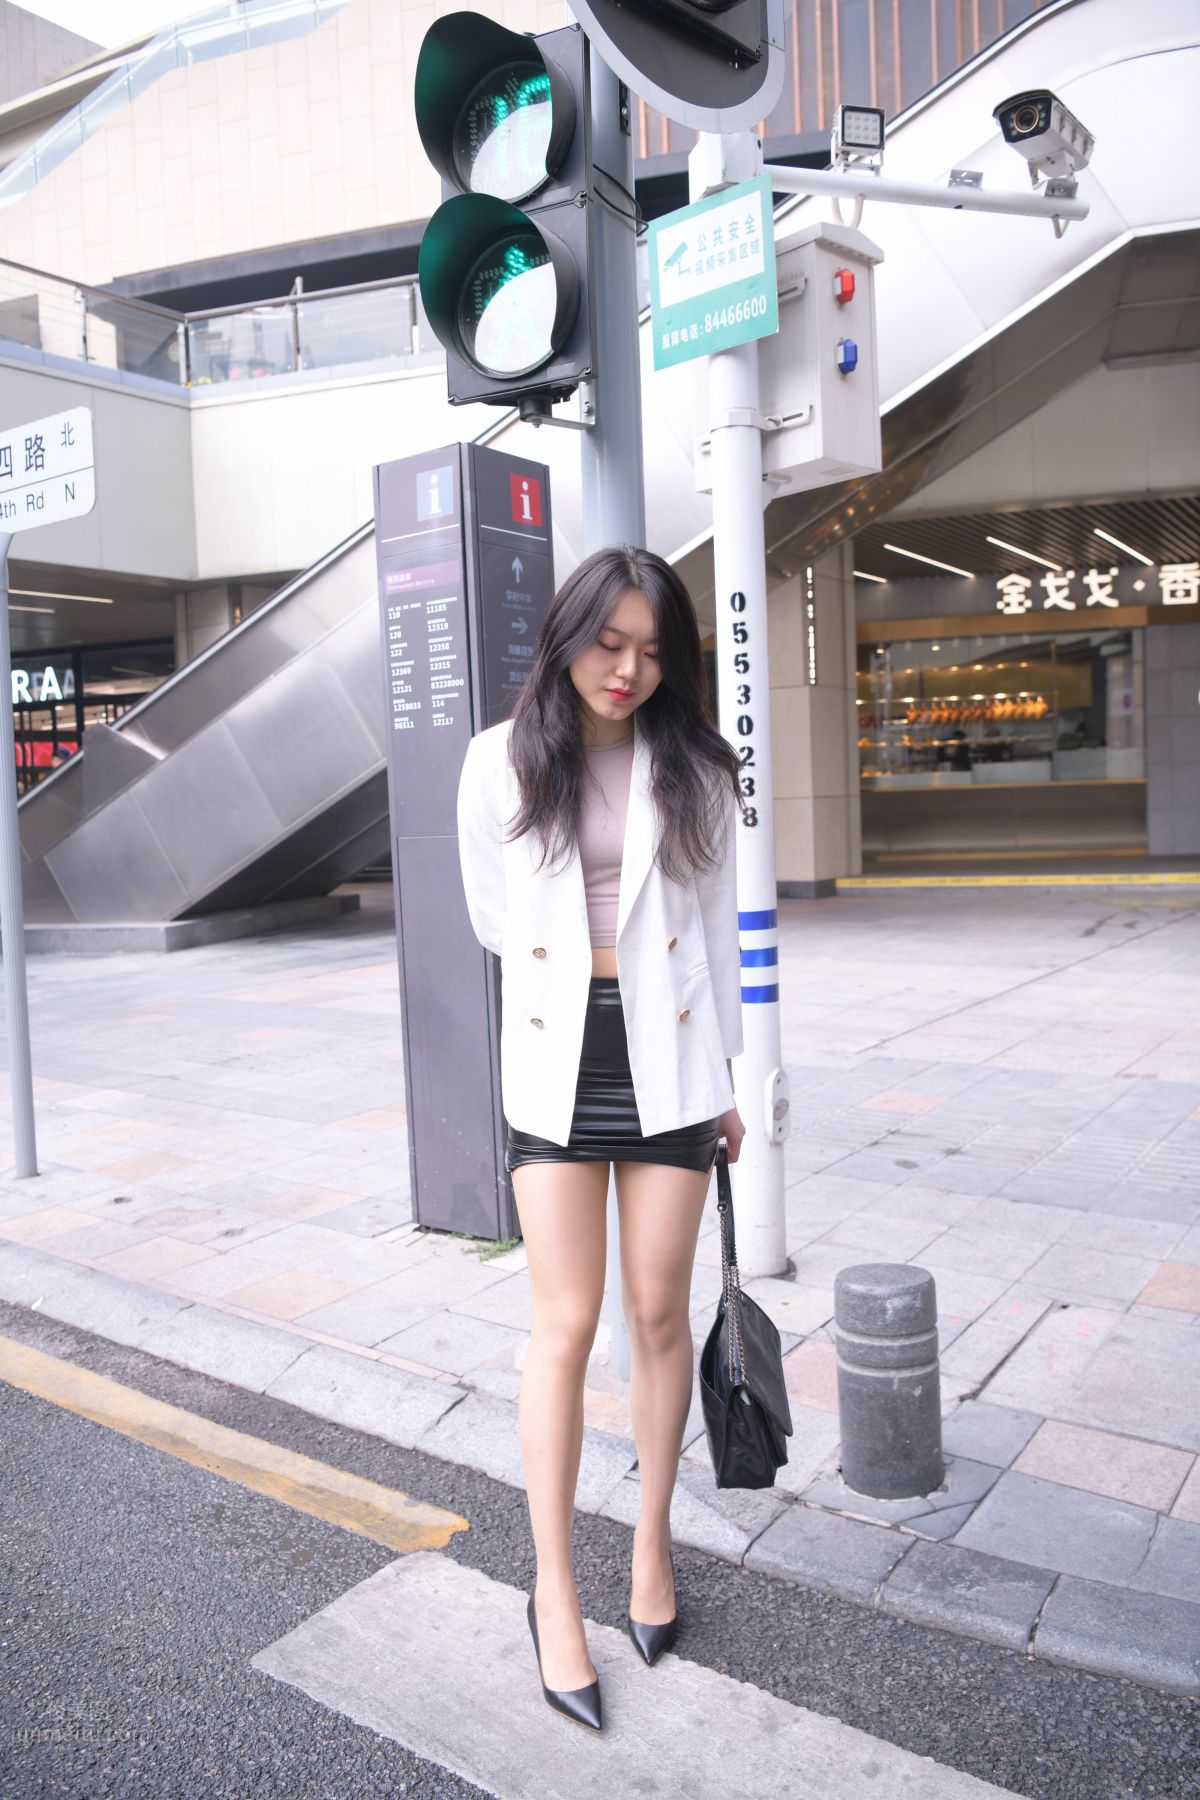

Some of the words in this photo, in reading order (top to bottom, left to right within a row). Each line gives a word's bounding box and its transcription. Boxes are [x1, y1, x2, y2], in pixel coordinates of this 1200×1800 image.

[697, 213, 755, 253] 公共安全
[60, 421, 75, 447] 北
[26, 490, 44, 513] Rd
[65, 481, 75, 503] N
[433, 717, 454, 727] 12117
